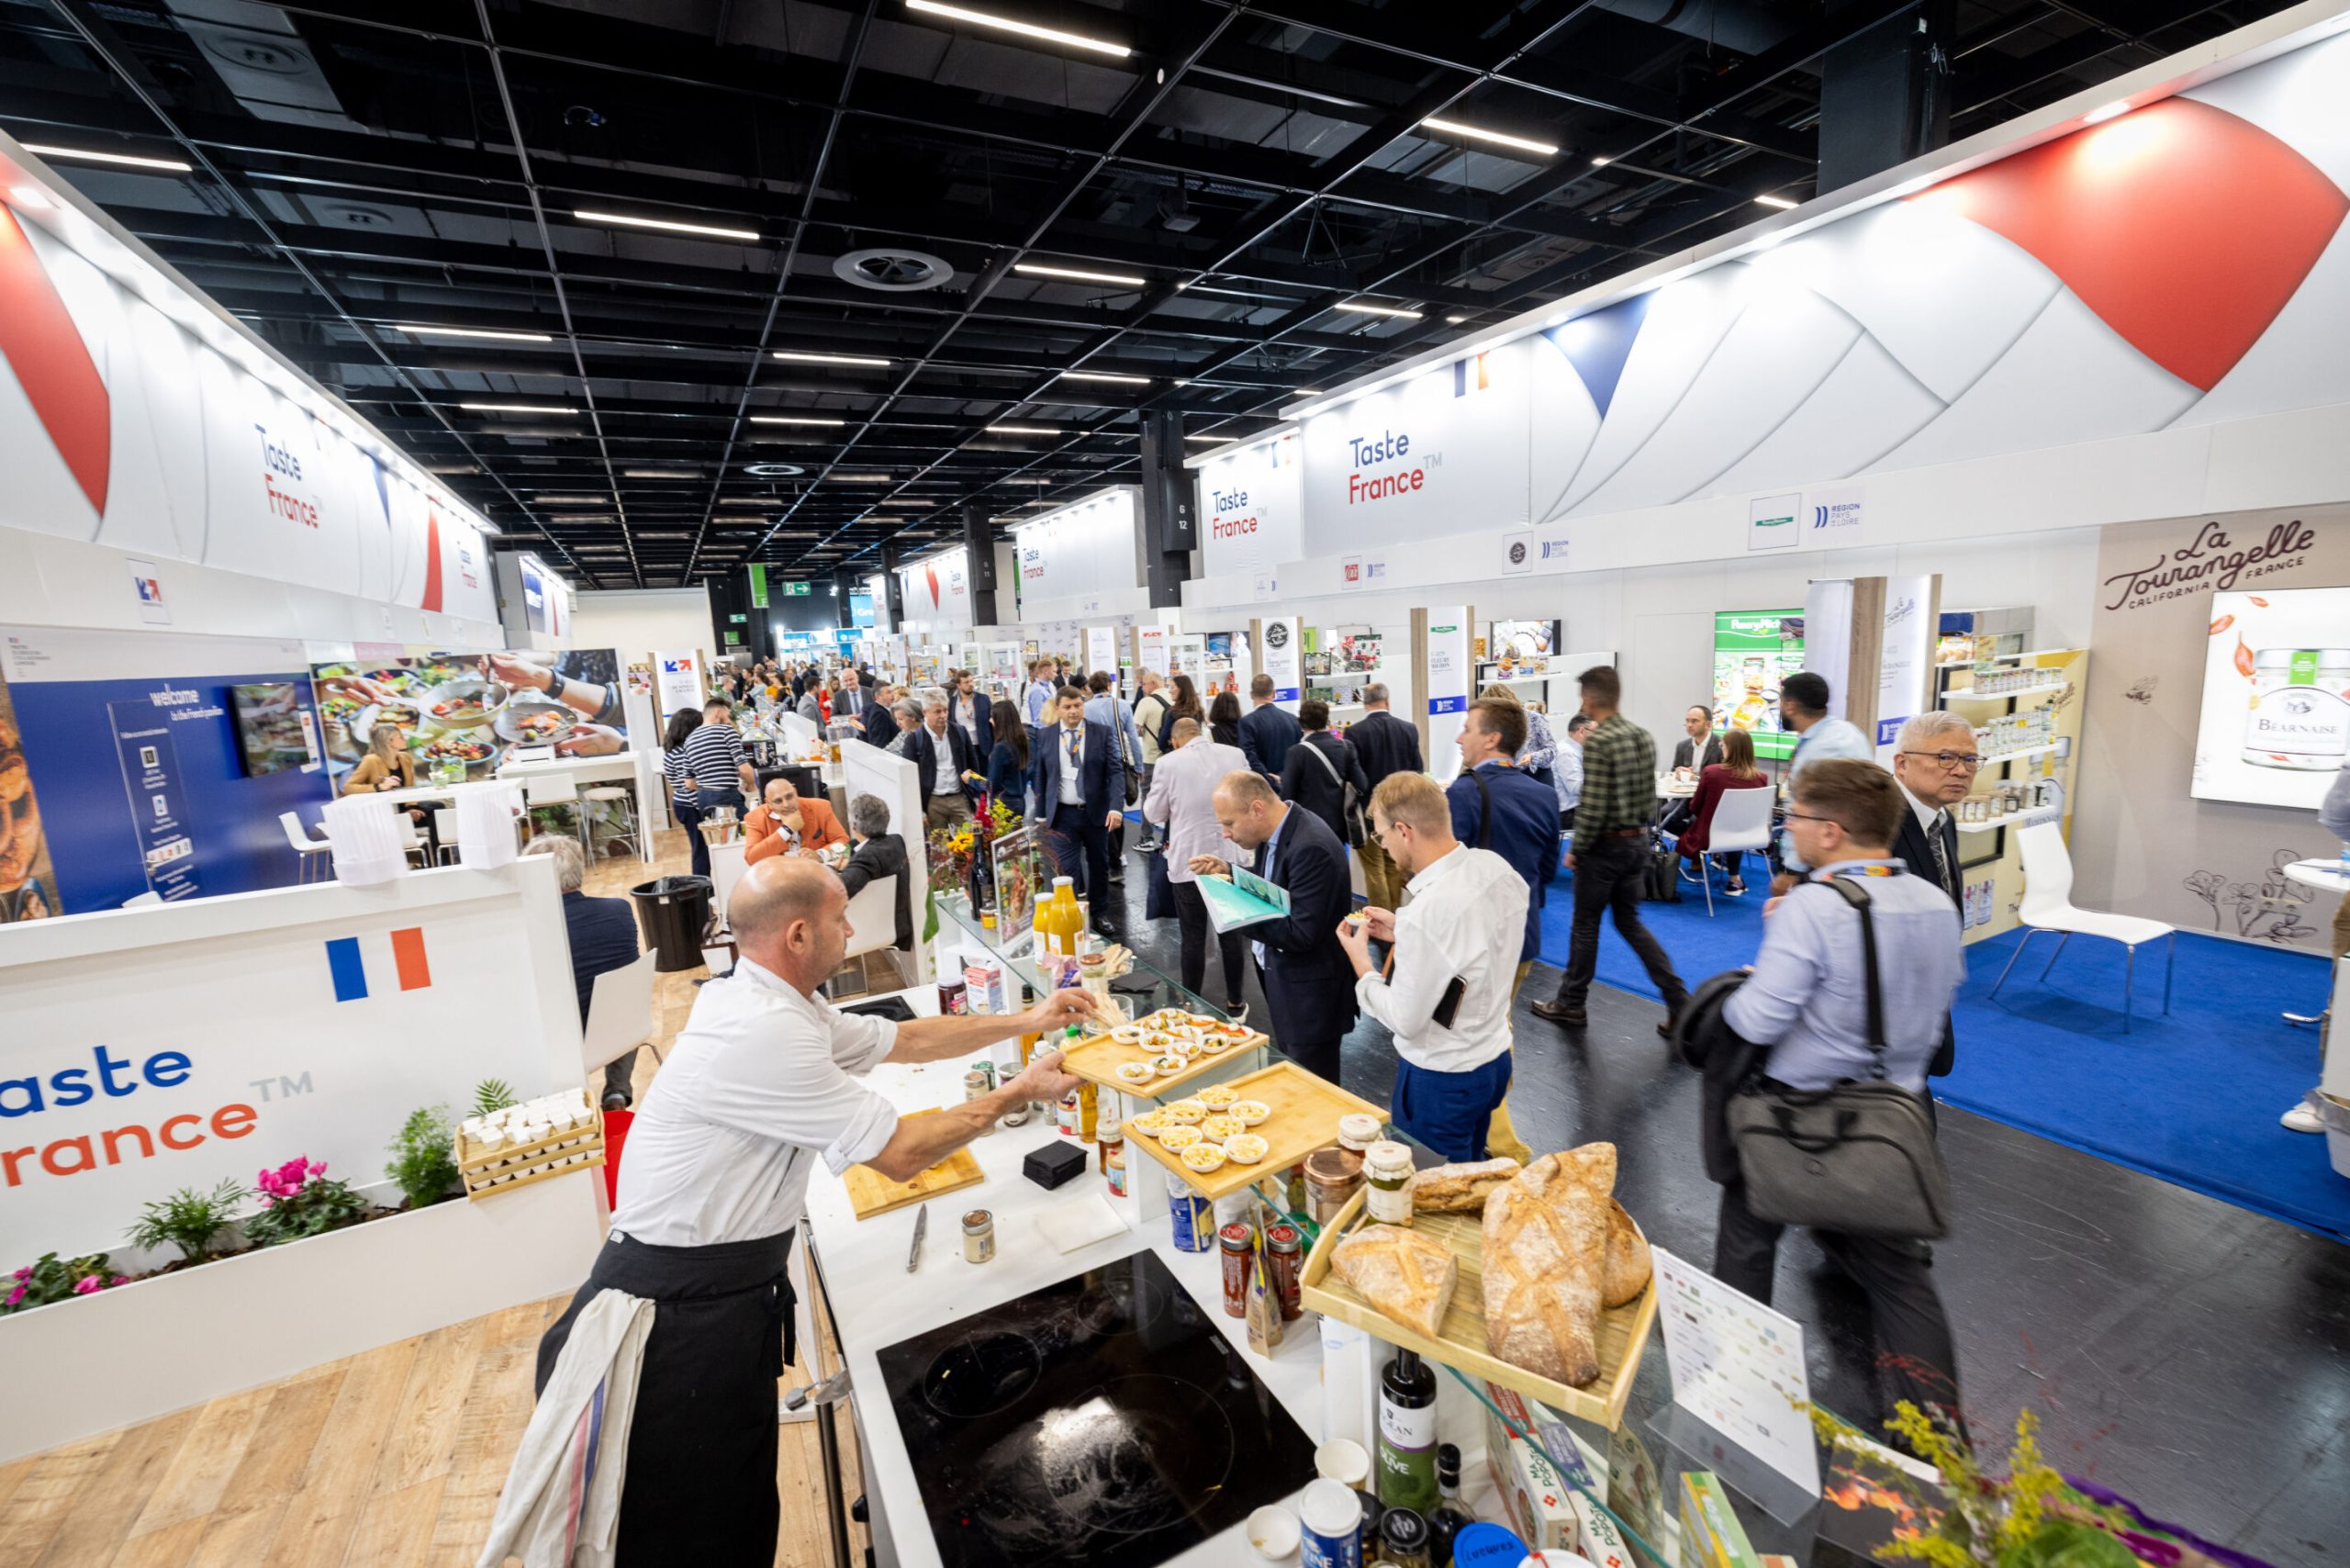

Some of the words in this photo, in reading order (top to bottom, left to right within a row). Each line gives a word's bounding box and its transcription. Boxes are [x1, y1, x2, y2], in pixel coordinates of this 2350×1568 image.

[254, 423, 302, 481] Taste
[1348, 430, 1409, 468] Taste
[264, 473, 319, 529] France
[1213, 487, 1248, 513] Taste
[1348, 468, 1424, 505] France
[1179, 520, 1188, 530] 12
[1213, 517, 1258, 540] France
[2175, 521, 2232, 562] La
[1024, 565, 1044, 580] France
[2104, 520, 2315, 610] Tourangelle
[2128, 581, 2211, 610] CALIFORNIA
[2245, 556, 2305, 580] FRANCE
[149, 683, 200, 706] welcome
[0, 1045, 193, 1119] aste
[0, 1103, 258, 1187] rance
[250, 1070, 314, 1102] TM
